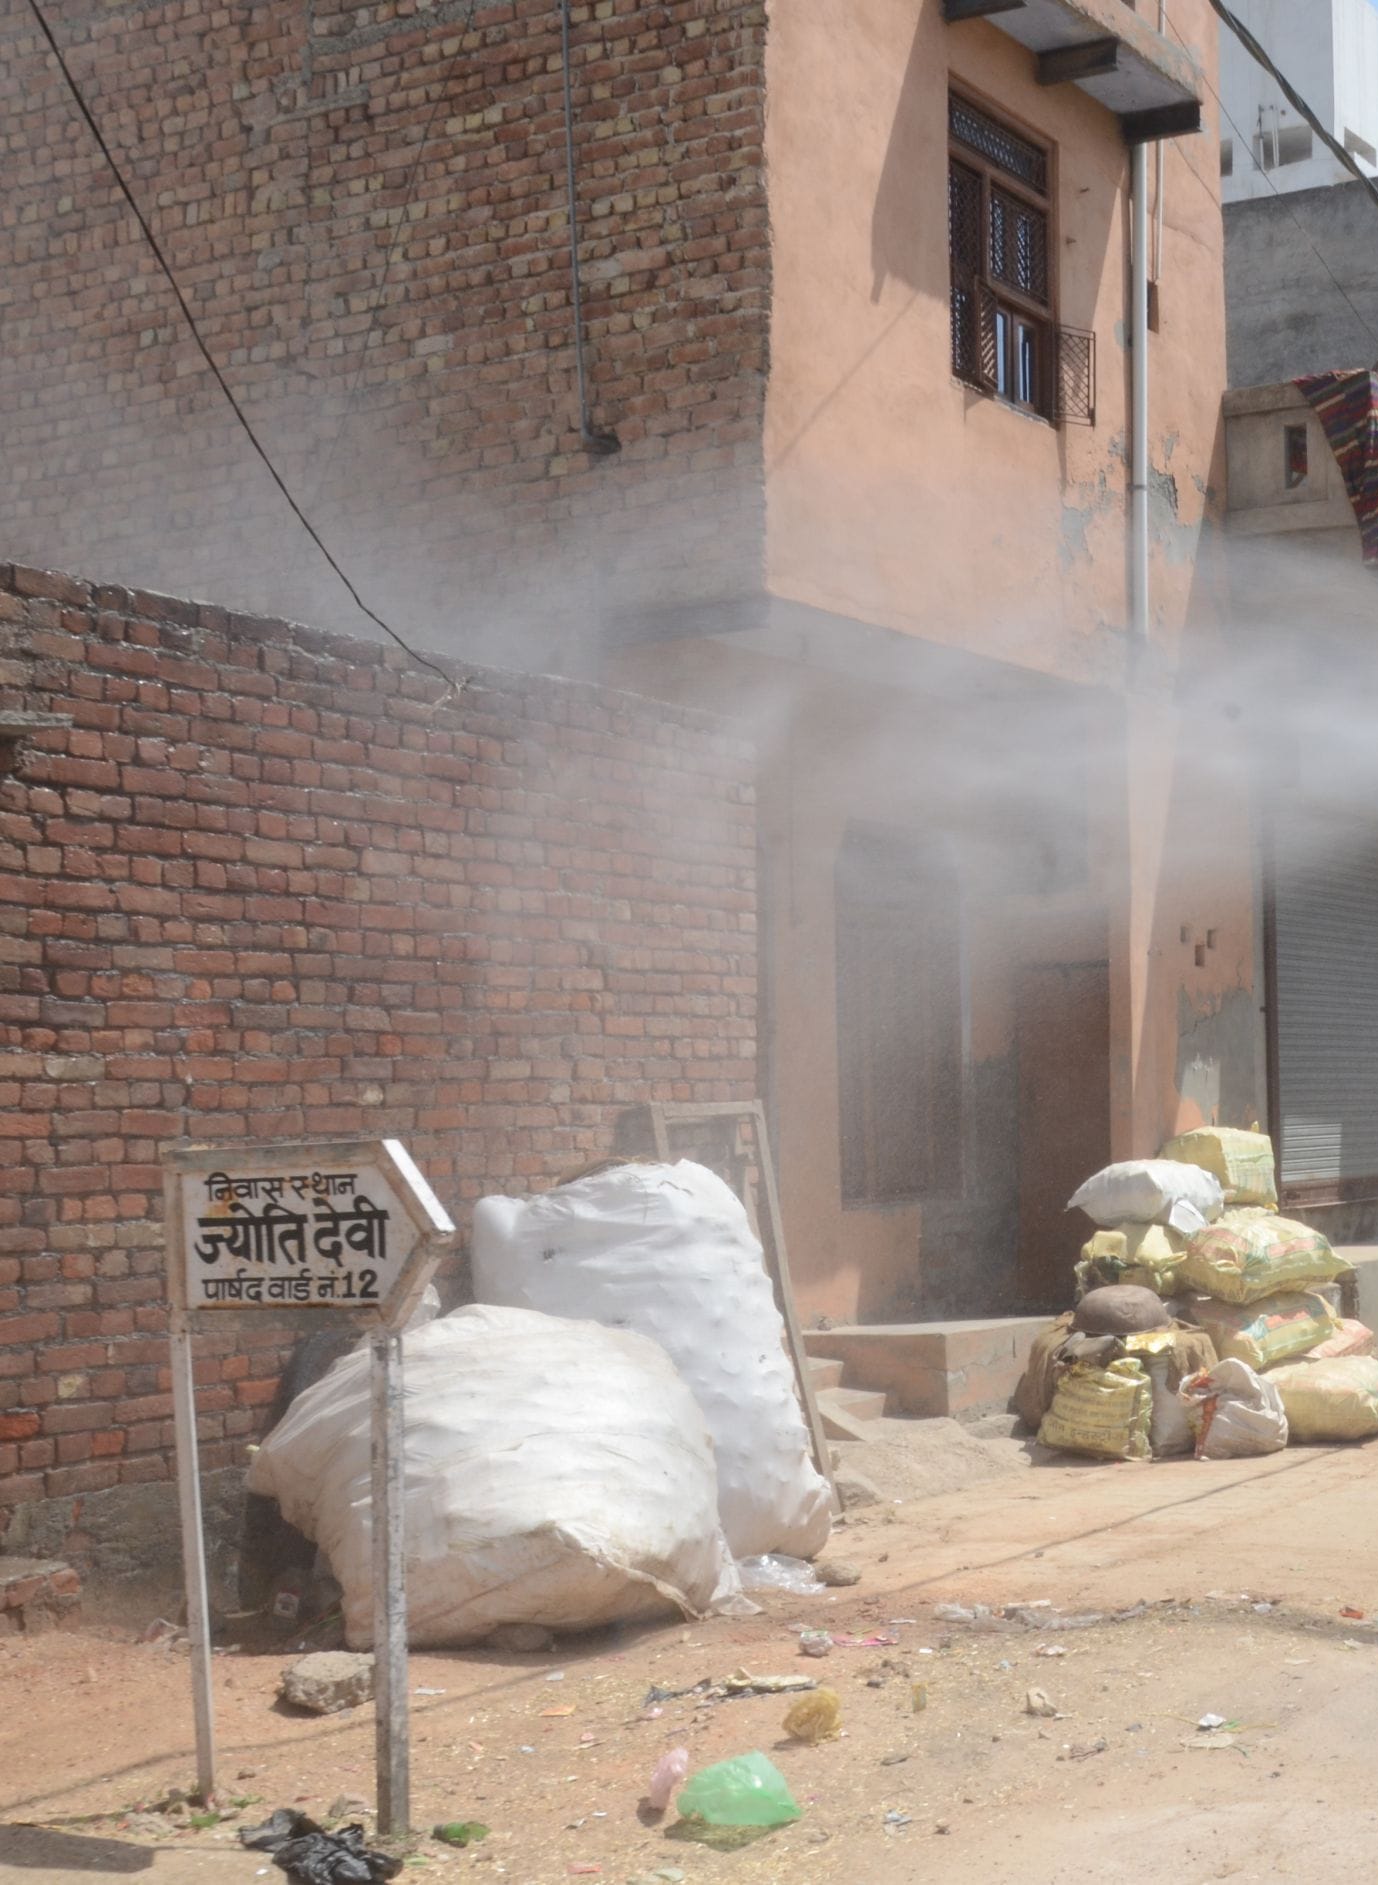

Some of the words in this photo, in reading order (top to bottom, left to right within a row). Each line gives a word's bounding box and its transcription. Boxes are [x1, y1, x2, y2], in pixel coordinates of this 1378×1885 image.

[204, 1172, 285, 1203] निवास
[290, 1172, 358, 1200] स्थान
[195, 1202, 308, 1265] ज्योति
[312, 1195, 390, 1267] देवी
[202, 1268, 265, 1303] पार्षद
[268, 1268, 312, 1301] वार्ड
